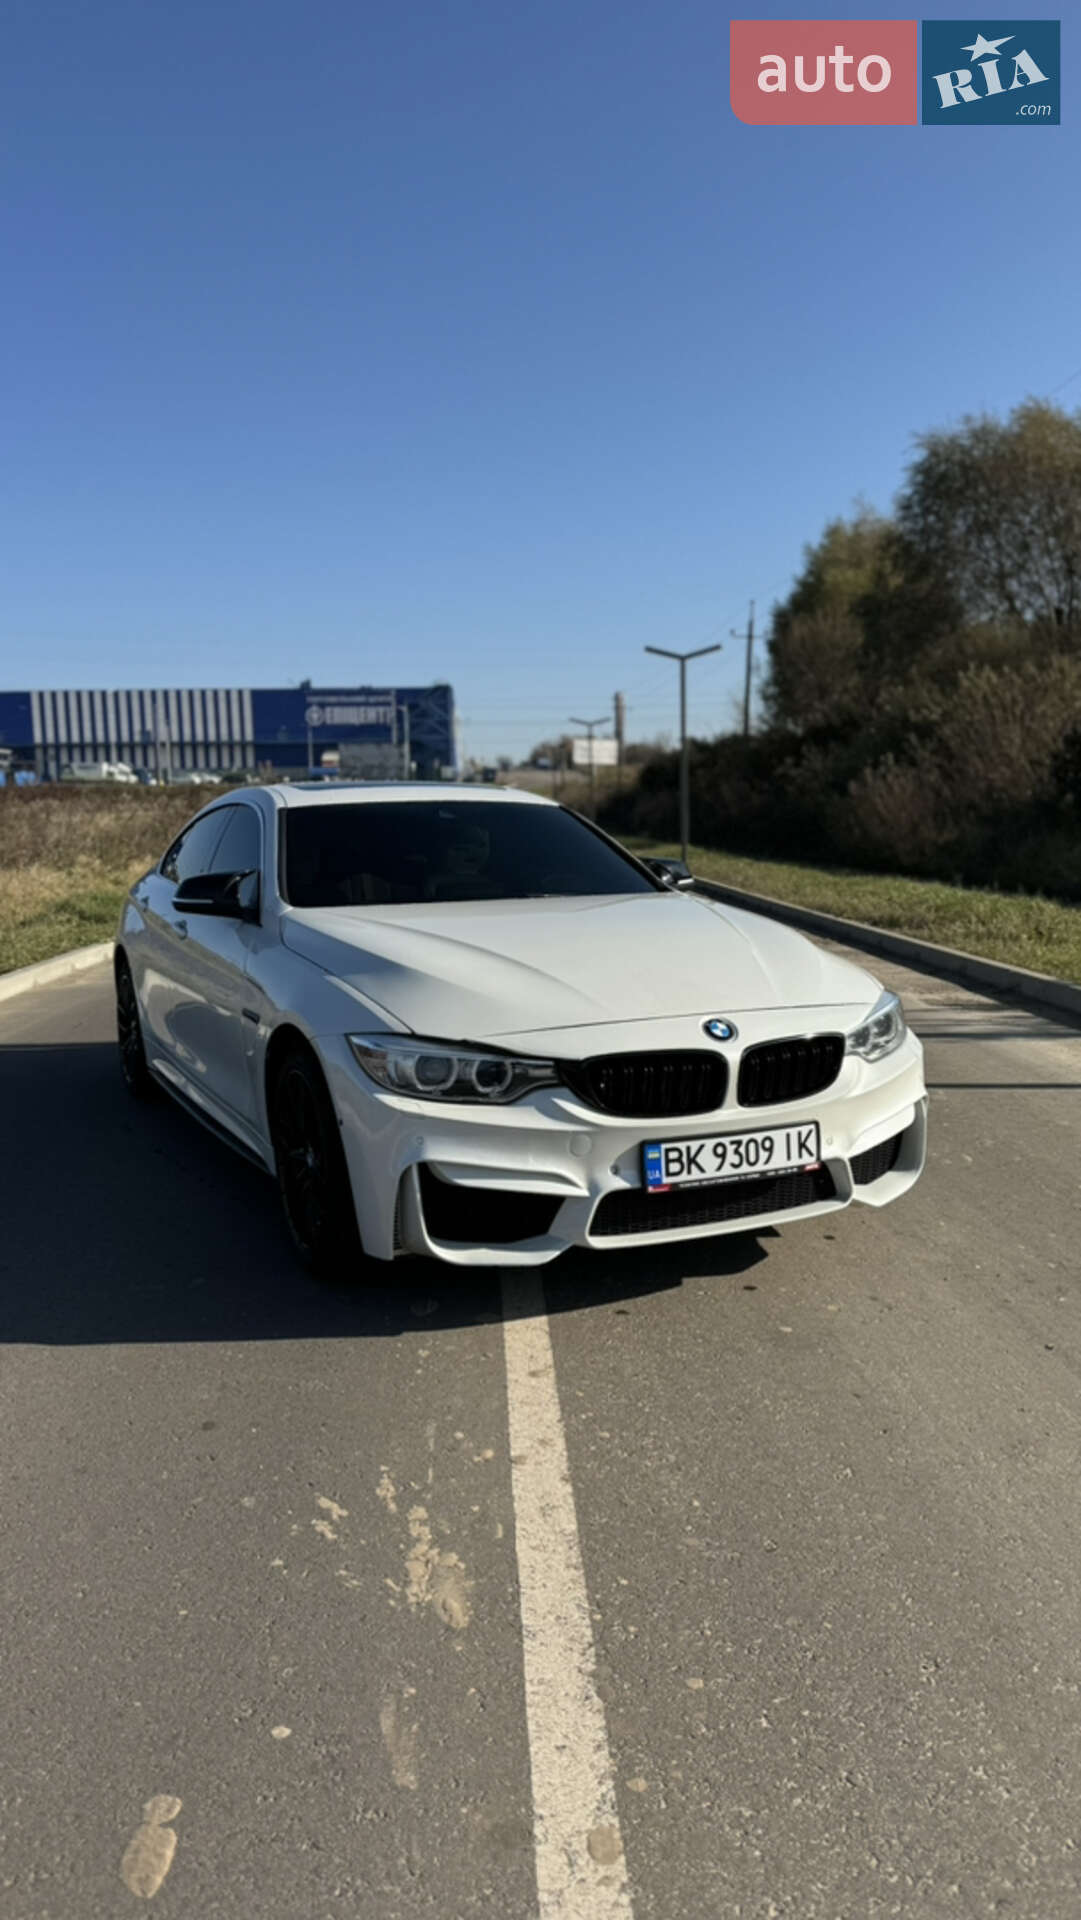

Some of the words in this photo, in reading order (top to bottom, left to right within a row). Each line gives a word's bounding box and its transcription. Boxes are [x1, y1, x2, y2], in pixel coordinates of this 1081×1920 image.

[664, 1144, 706, 1177] BK
[712, 1136, 774, 1172] 9309
[786, 1128, 815, 1161] IK
[648, 1169, 661, 1180] UA
